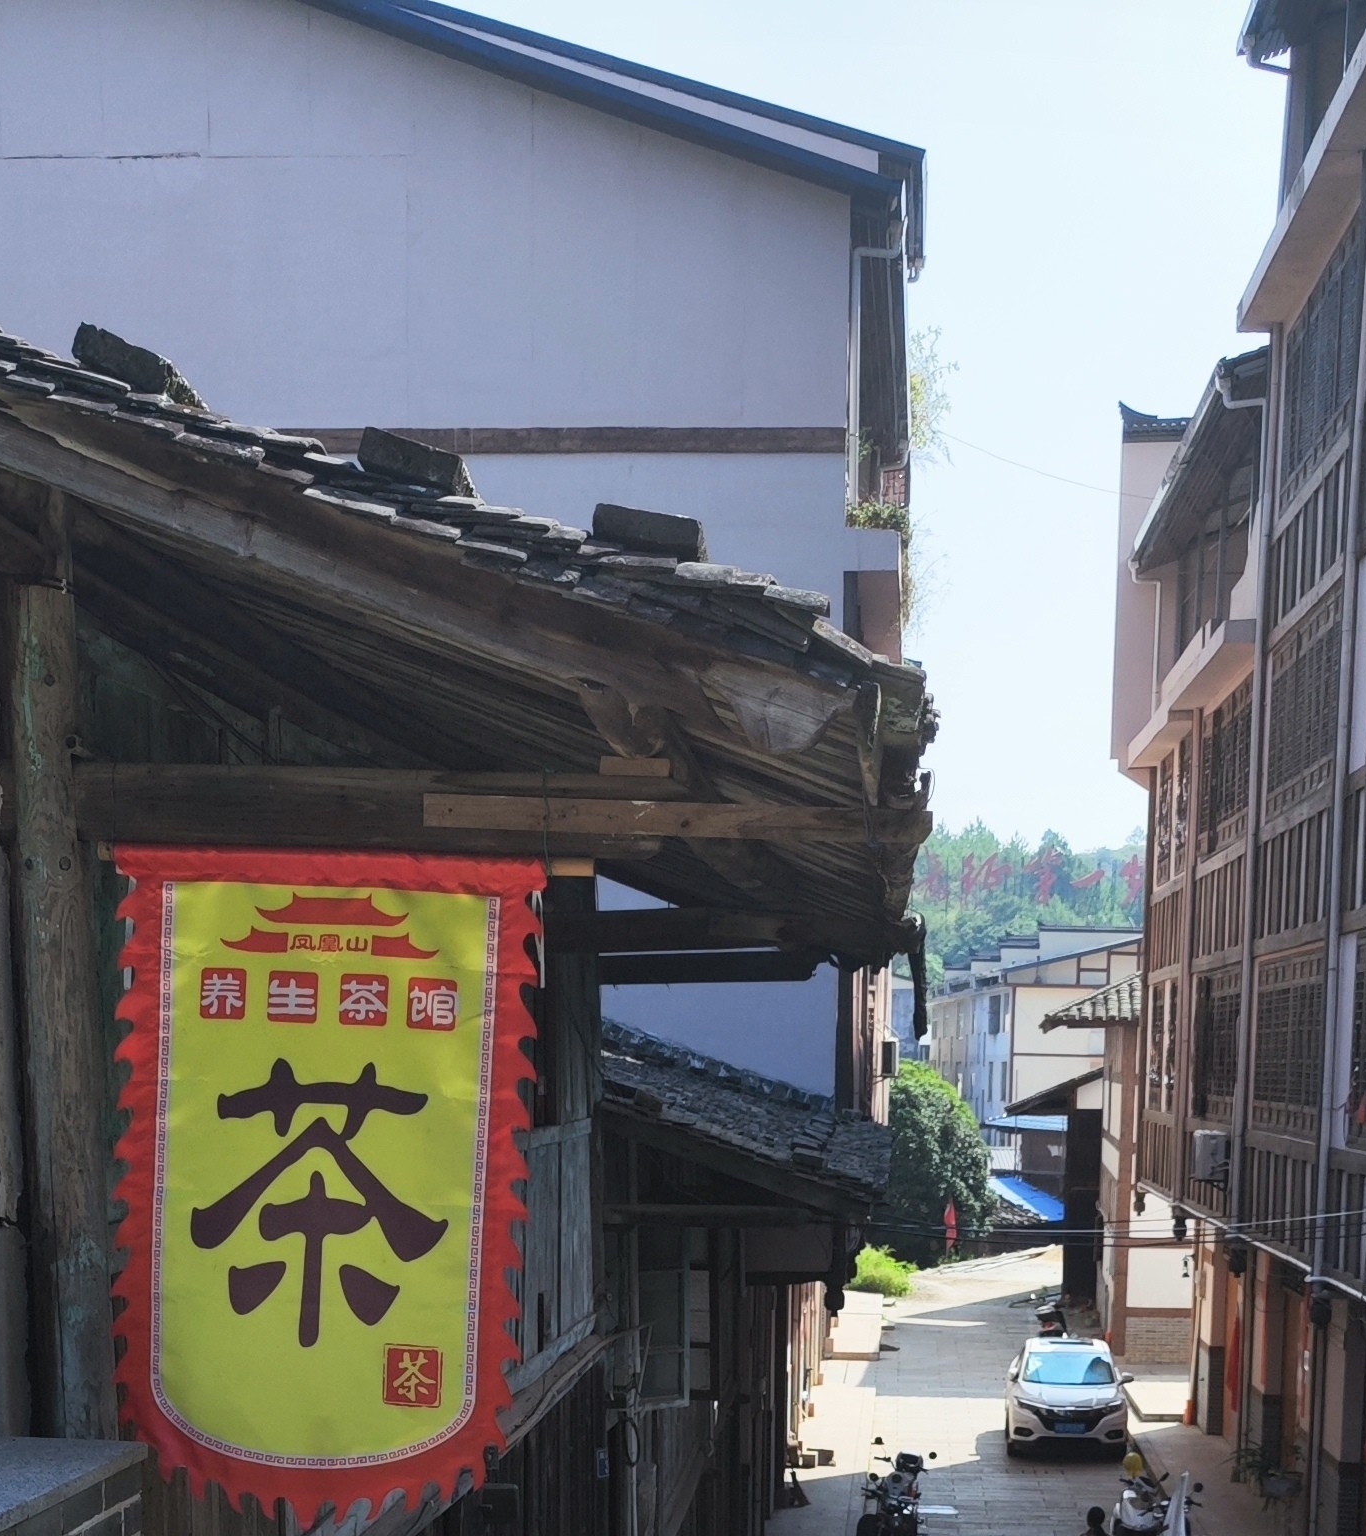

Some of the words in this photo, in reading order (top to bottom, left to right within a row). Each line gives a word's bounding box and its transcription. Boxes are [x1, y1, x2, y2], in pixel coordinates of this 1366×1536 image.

[289, 933, 369, 954] 凤凰山
[200, 972, 458, 1028] 养生茶馆
[190, 1057, 450, 1349] 茶
[392, 1352, 436, 1402] 茶
